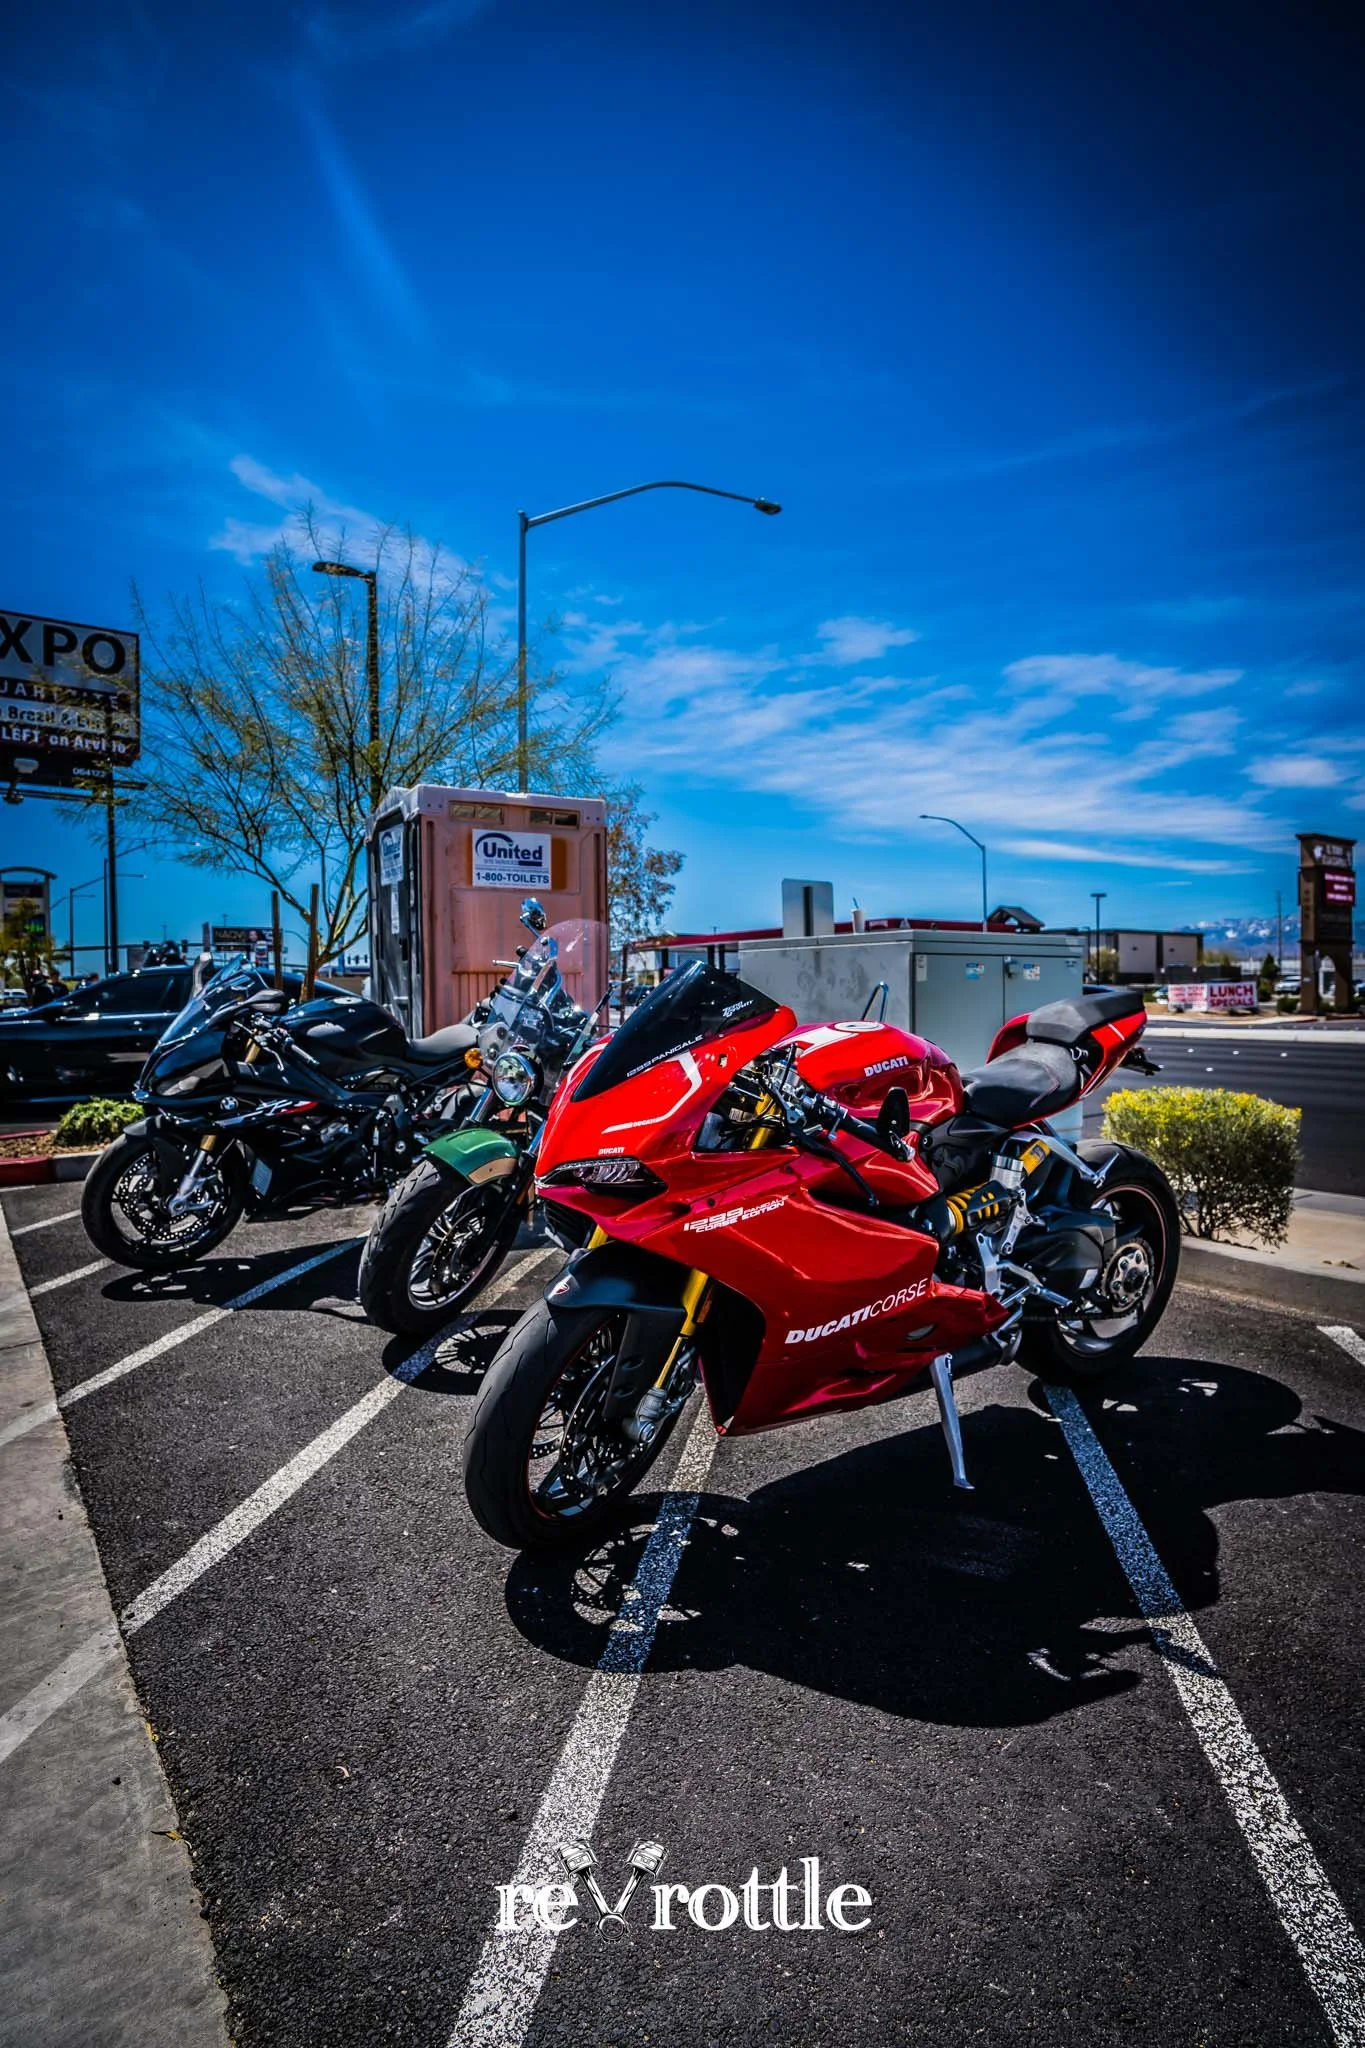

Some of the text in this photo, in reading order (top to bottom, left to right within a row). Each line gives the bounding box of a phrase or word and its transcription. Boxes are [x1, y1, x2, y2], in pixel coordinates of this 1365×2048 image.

[1, 726, 41, 743] LEFT
[483, 841, 543, 860] United
[476, 872, 549, 884] 1-800-TOILETS
[1210, 984, 1254, 997] LUNCH
[1210, 997, 1254, 1007] SPECIALS
[652, 1034, 703, 1063] PANIGALE
[864, 1056, 908, 1077] DUCATI
[598, 1147, 625, 1155] DUCATI
[683, 1207, 743, 1231] 1299
[741, 1201, 785, 1220] EDITION
